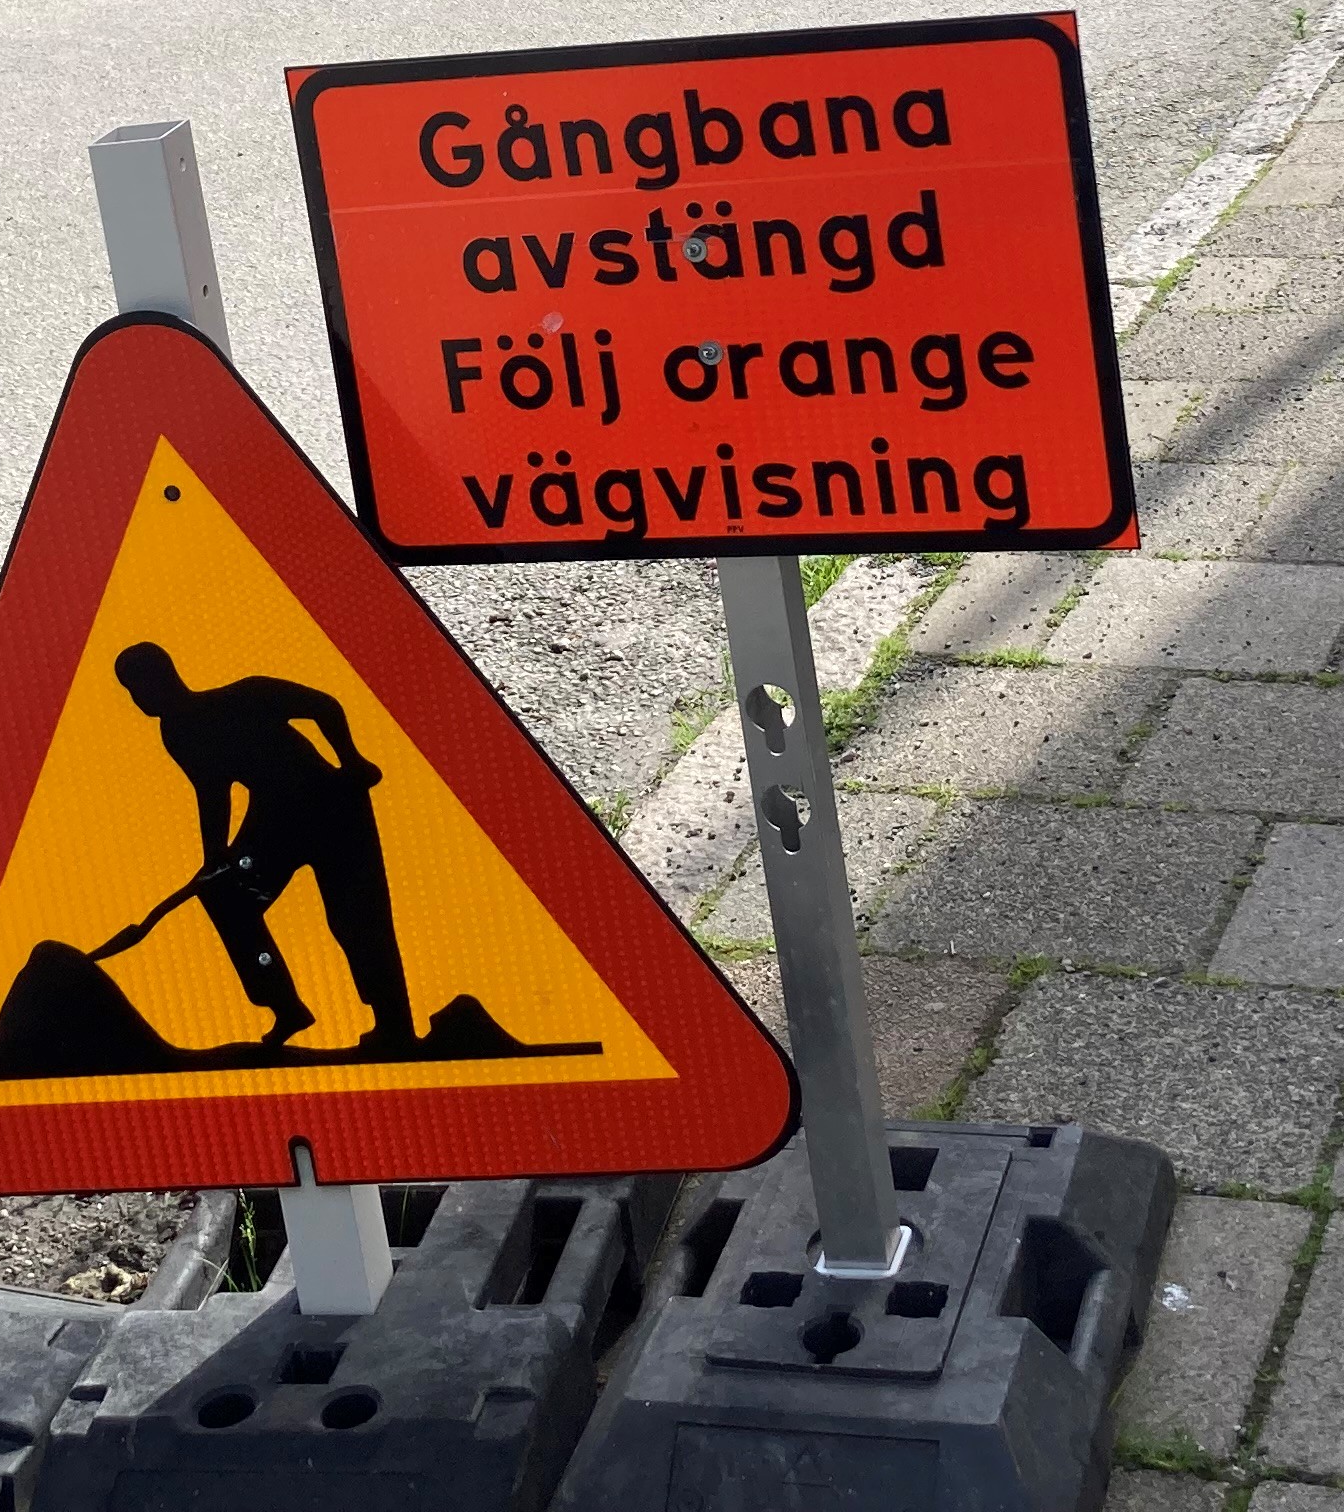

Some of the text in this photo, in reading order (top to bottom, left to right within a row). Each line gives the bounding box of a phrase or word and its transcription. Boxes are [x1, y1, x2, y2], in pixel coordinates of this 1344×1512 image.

[419, 88, 952, 192] Gångbana
[462, 189, 945, 294] avstängd
[440, 329, 1035, 426] Följ orange
[461, 436, 1032, 541] vägvisning
